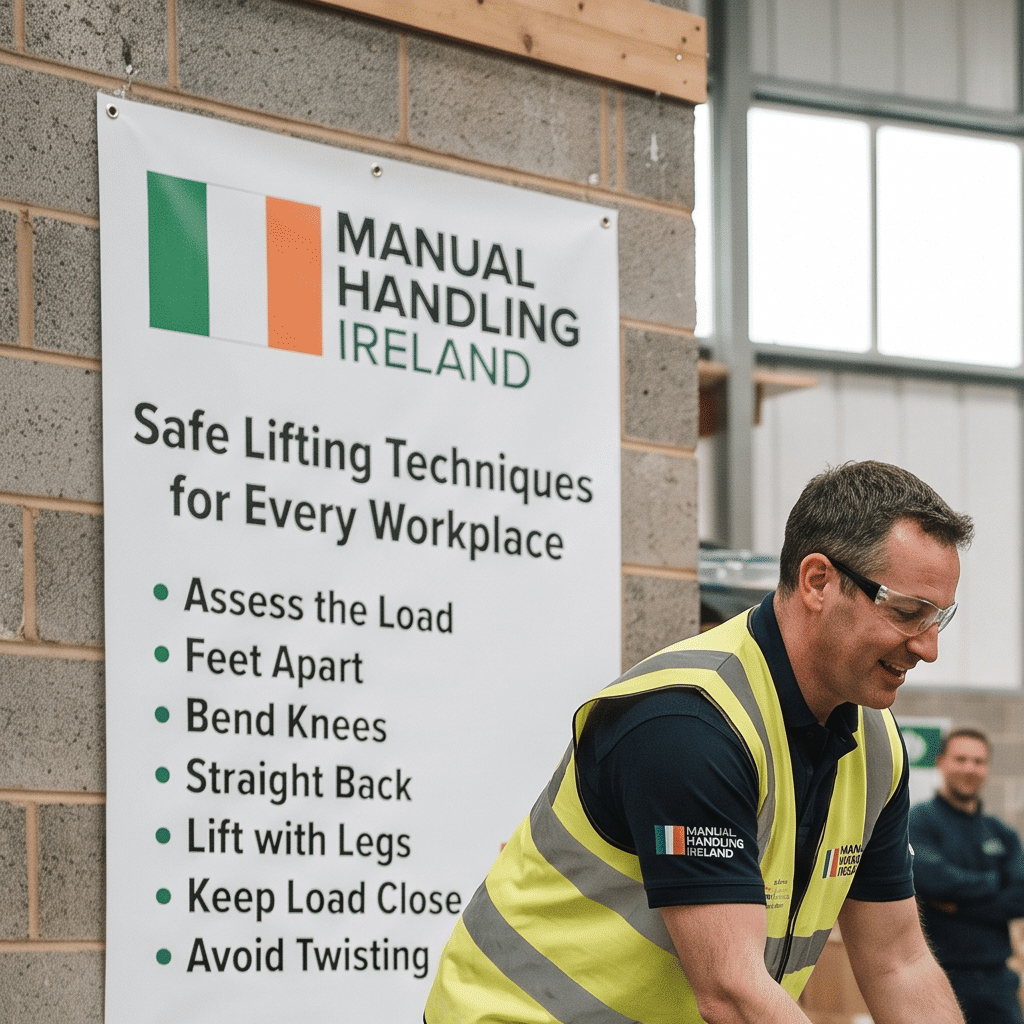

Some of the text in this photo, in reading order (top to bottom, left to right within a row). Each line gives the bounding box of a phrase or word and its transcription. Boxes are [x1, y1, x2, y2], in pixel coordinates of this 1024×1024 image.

[337, 211, 535, 290] MANUAL
[338, 265, 580, 348] HANDLING
[340, 319, 532, 389] IRELAND
[133, 401, 593, 505] Safe Lifting Techniques
[169, 473, 564, 562] for Every Workplace
[183, 576, 453, 634] Assess the Load
[186, 637, 364, 689] Feet Apart
[186, 697, 387, 743] Bend Knees
[186, 757, 412, 806] Straight Back
[188, 817, 411, 867] Lift with Legs
[685, 826, 737, 838] MANUAL
[685, 846, 734, 859] IRELAND
[188, 877, 462, 923] Keep Load Close
[186, 936, 429, 980] Avoid Twisting
